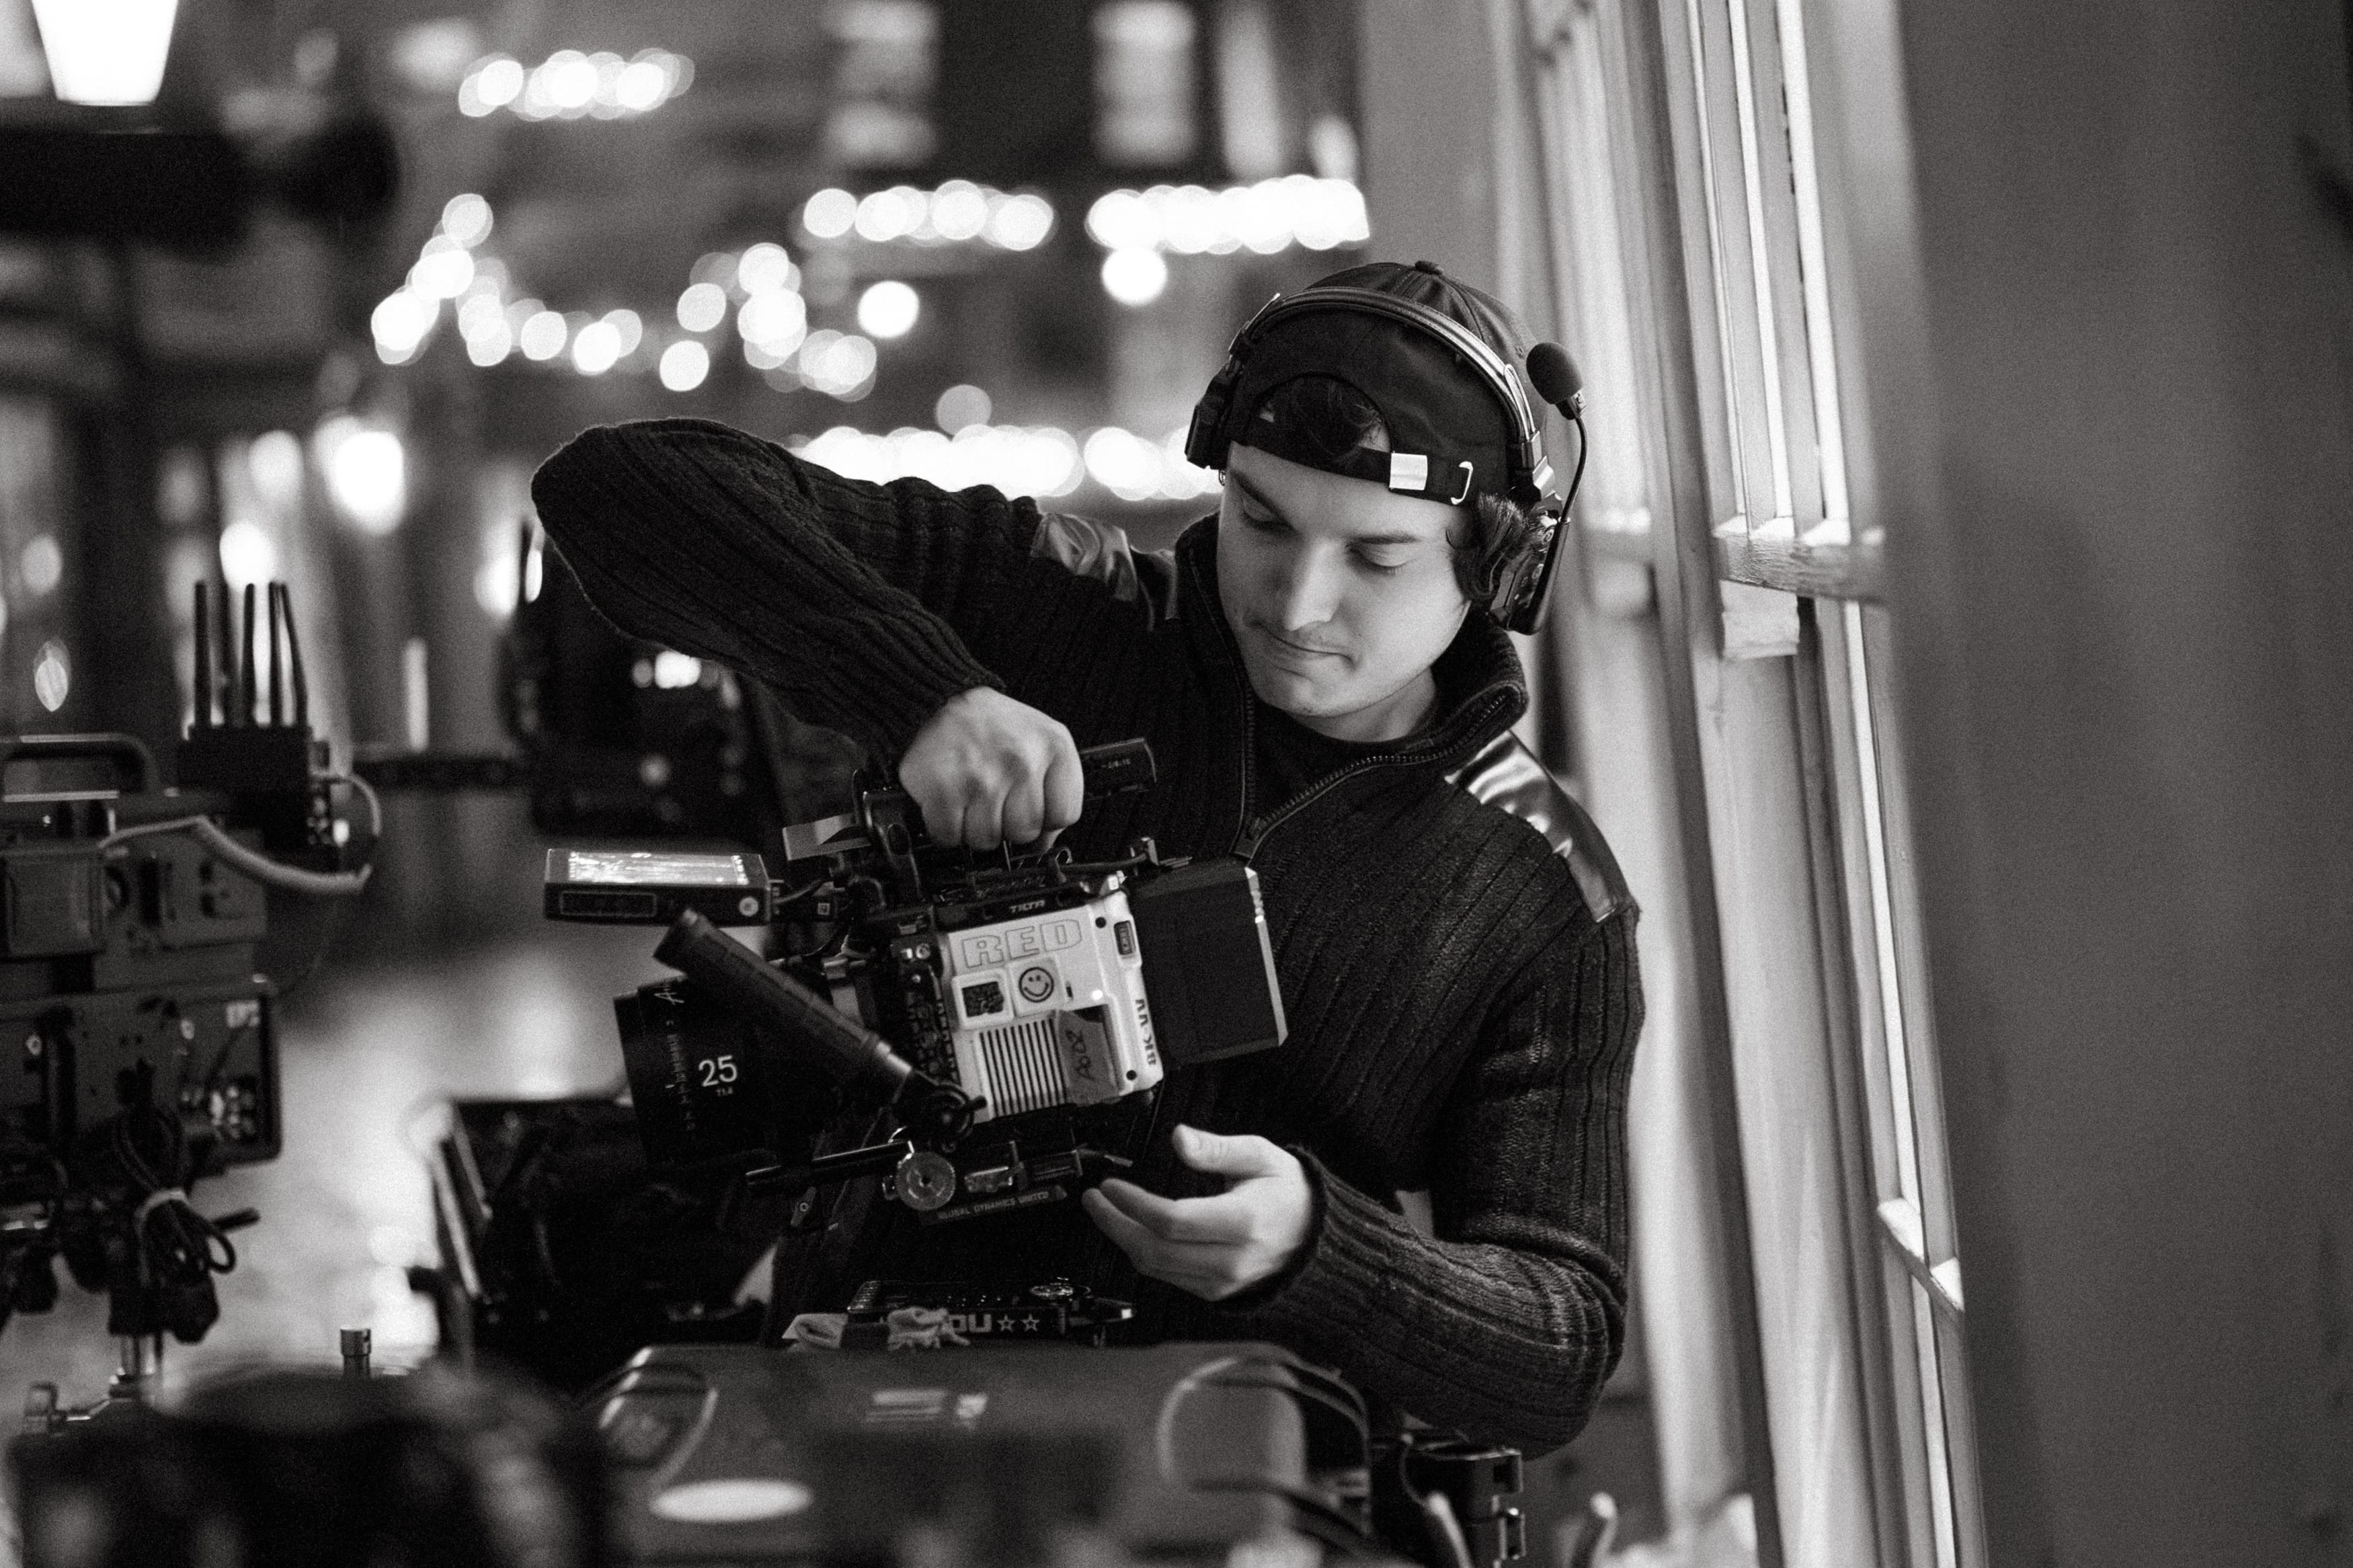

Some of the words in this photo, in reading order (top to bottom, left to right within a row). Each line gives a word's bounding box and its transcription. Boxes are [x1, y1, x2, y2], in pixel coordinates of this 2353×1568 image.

[1010, 900, 1045, 913] TILTA
[961, 919, 1082, 968] RED
[698, 1055, 738, 1087] 25
